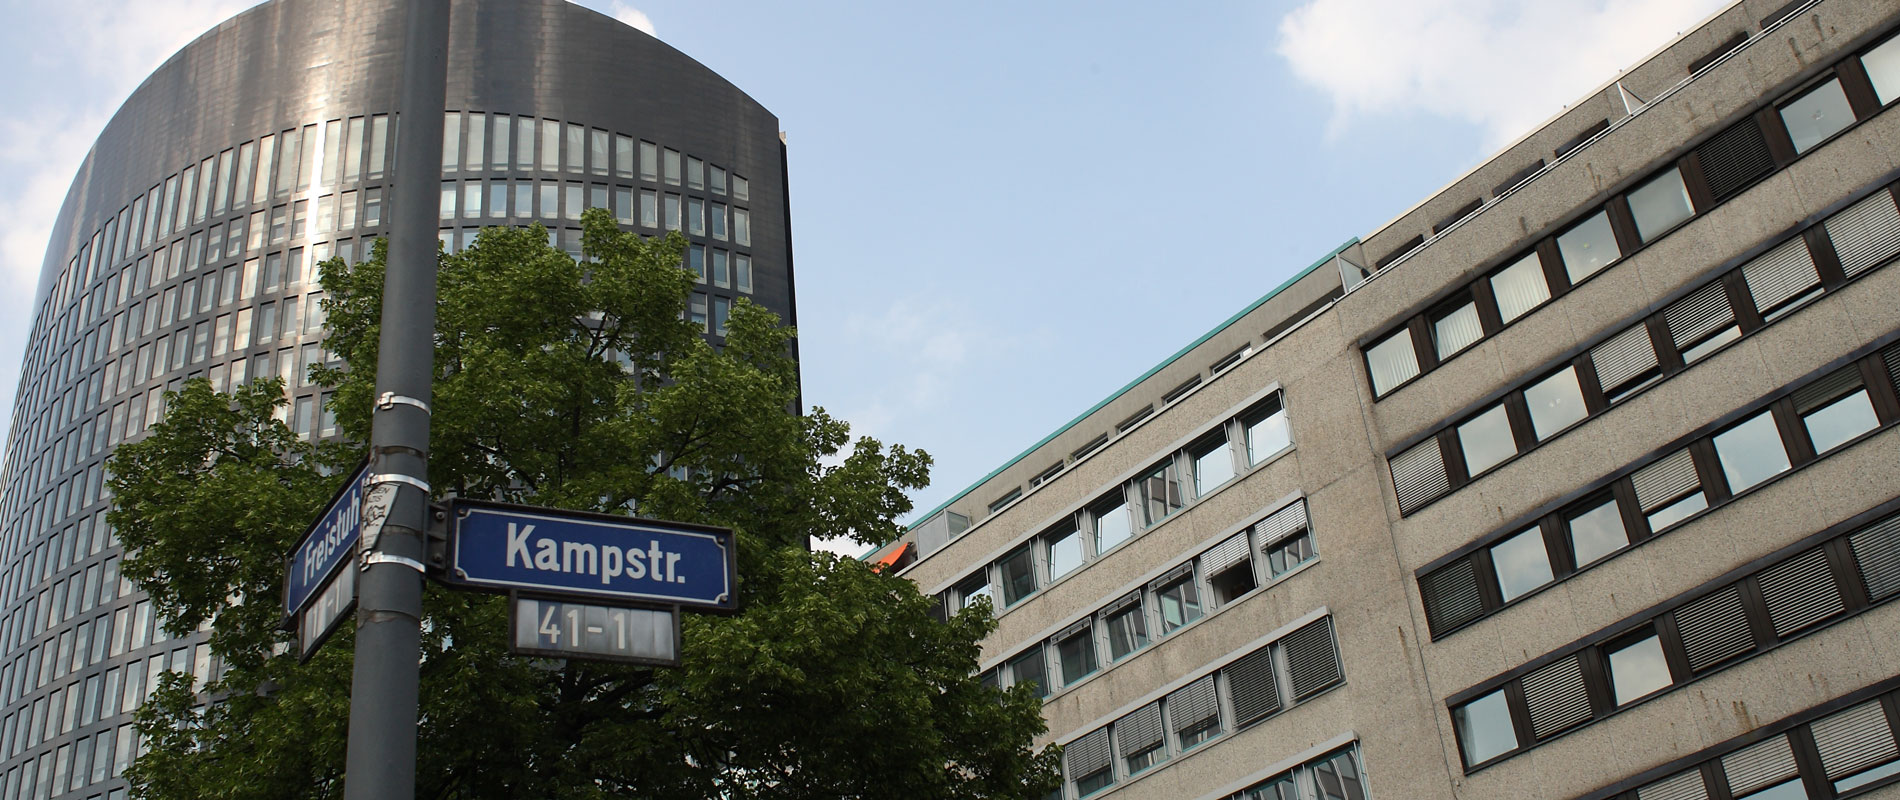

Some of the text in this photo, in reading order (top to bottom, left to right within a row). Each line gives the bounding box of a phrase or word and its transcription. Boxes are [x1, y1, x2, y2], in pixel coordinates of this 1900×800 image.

[303, 481, 364, 587] Freistuh
[505, 522, 686, 584] Kampstr.
[539, 605, 626, 650] 41-1
